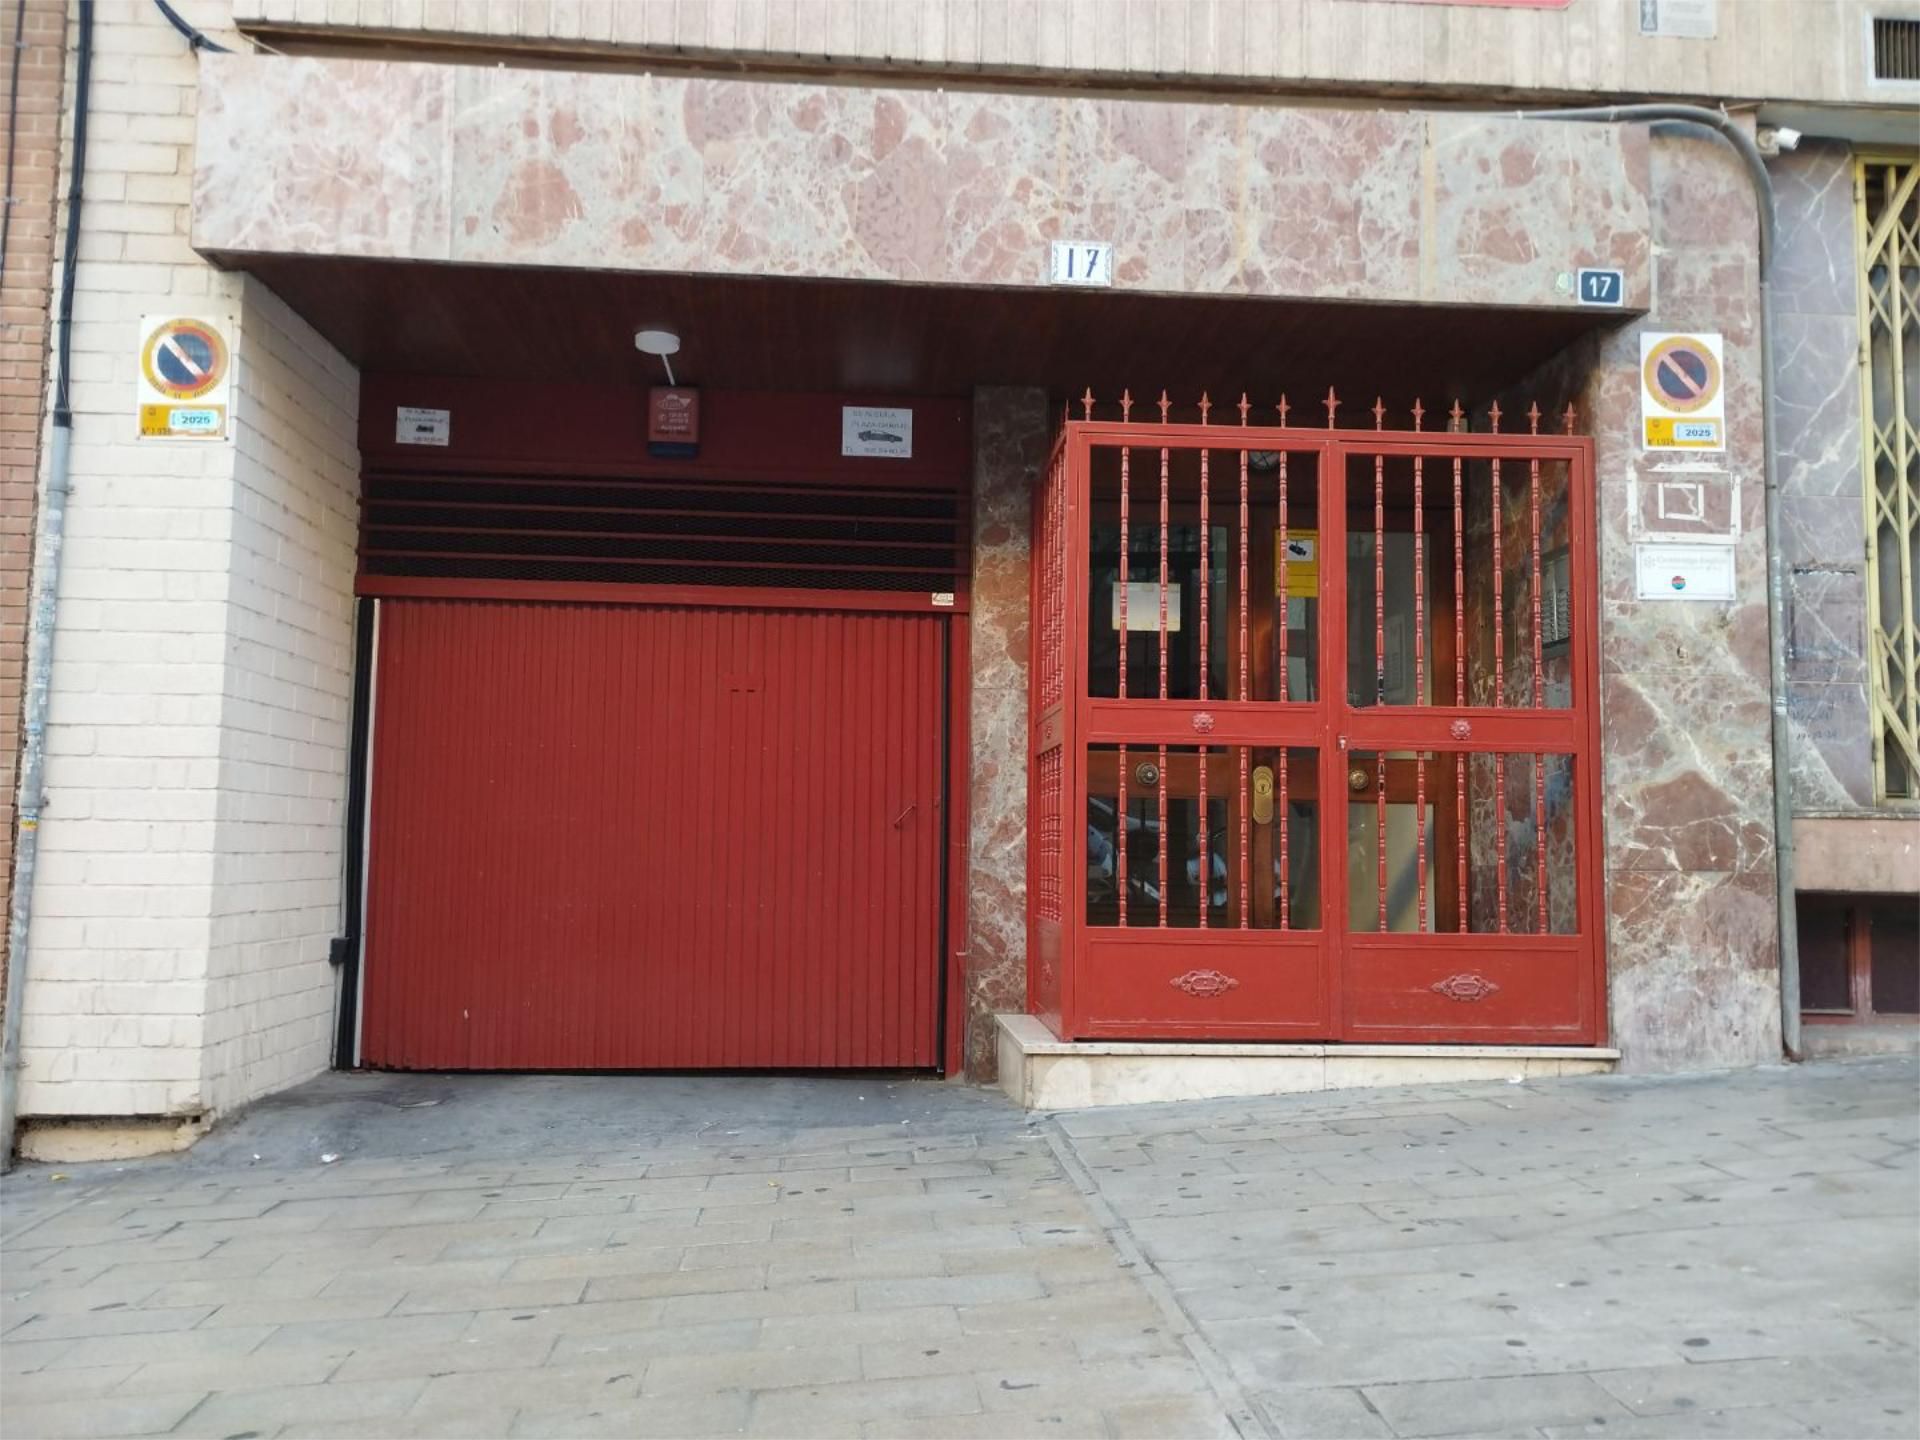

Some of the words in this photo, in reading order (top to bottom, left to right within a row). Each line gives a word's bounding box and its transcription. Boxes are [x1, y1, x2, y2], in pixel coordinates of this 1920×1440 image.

[1067, 248, 1099, 278] 17
[1589, 276, 1612, 297] 17
[181, 415, 211, 425] 2025
[1685, 428, 1712, 437] 2025
